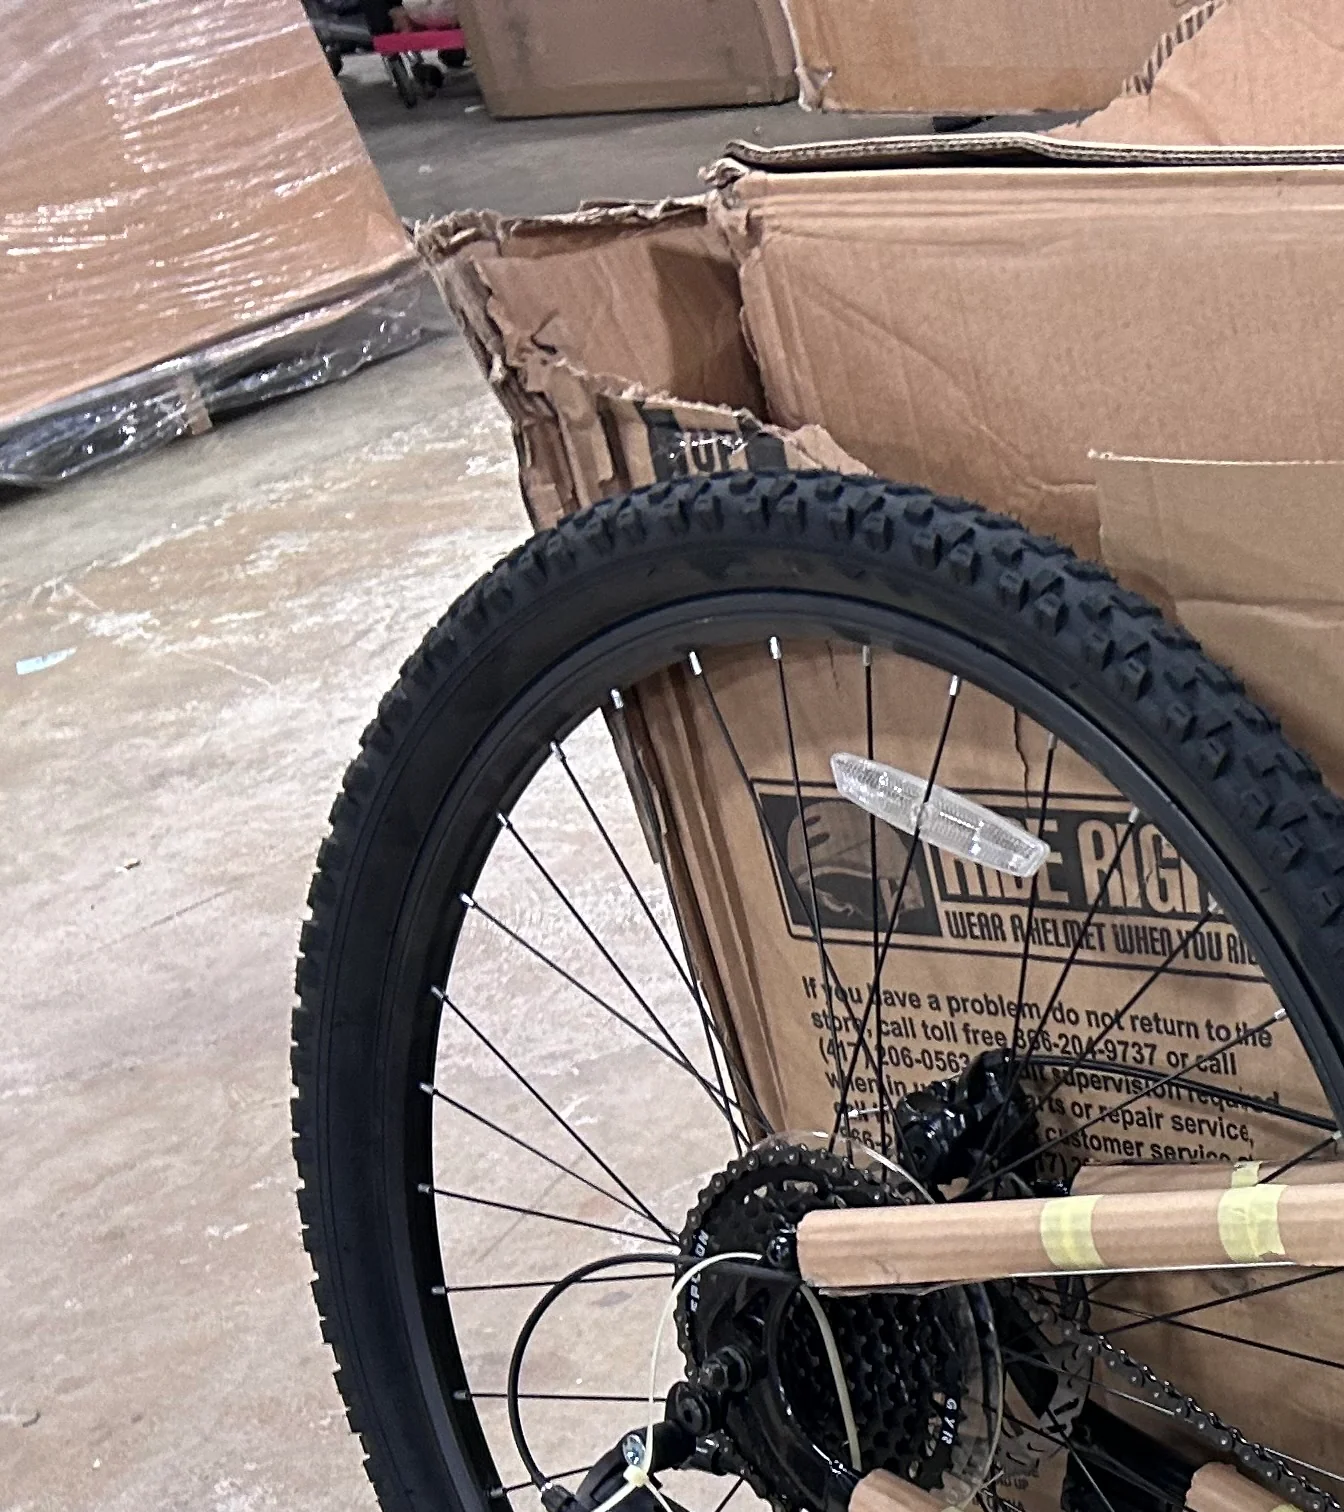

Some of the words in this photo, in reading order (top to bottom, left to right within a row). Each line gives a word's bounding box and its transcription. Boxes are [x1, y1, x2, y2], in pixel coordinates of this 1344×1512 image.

[944, 911, 1007, 943] WEAR
[1030, 919, 1106, 952] HELMET
[1112, 924, 1174, 957] WHEN
[1176, 928, 1223, 962] YOU
[802, 976, 817, 999] If
[926, 995, 941, 1011] a
[1052, 1001, 1080, 1025] do
[1086, 1009, 1124, 1031] not
[1130, 1012, 1199, 1039] return
[1205, 1020, 1231, 1042] to
[1236, 1022, 1273, 1048] the
[880, 1018, 916, 1038] call
[921, 1020, 958, 1043] toll
[963, 1023, 1007, 1047] free
[1166, 1051, 1189, 1069] or
[1196, 1051, 1238, 1075] call
[1071, 1100, 1093, 1120] or
[1100, 1104, 1164, 1132] repair
[1172, 1113, 1255, 1147] service,
